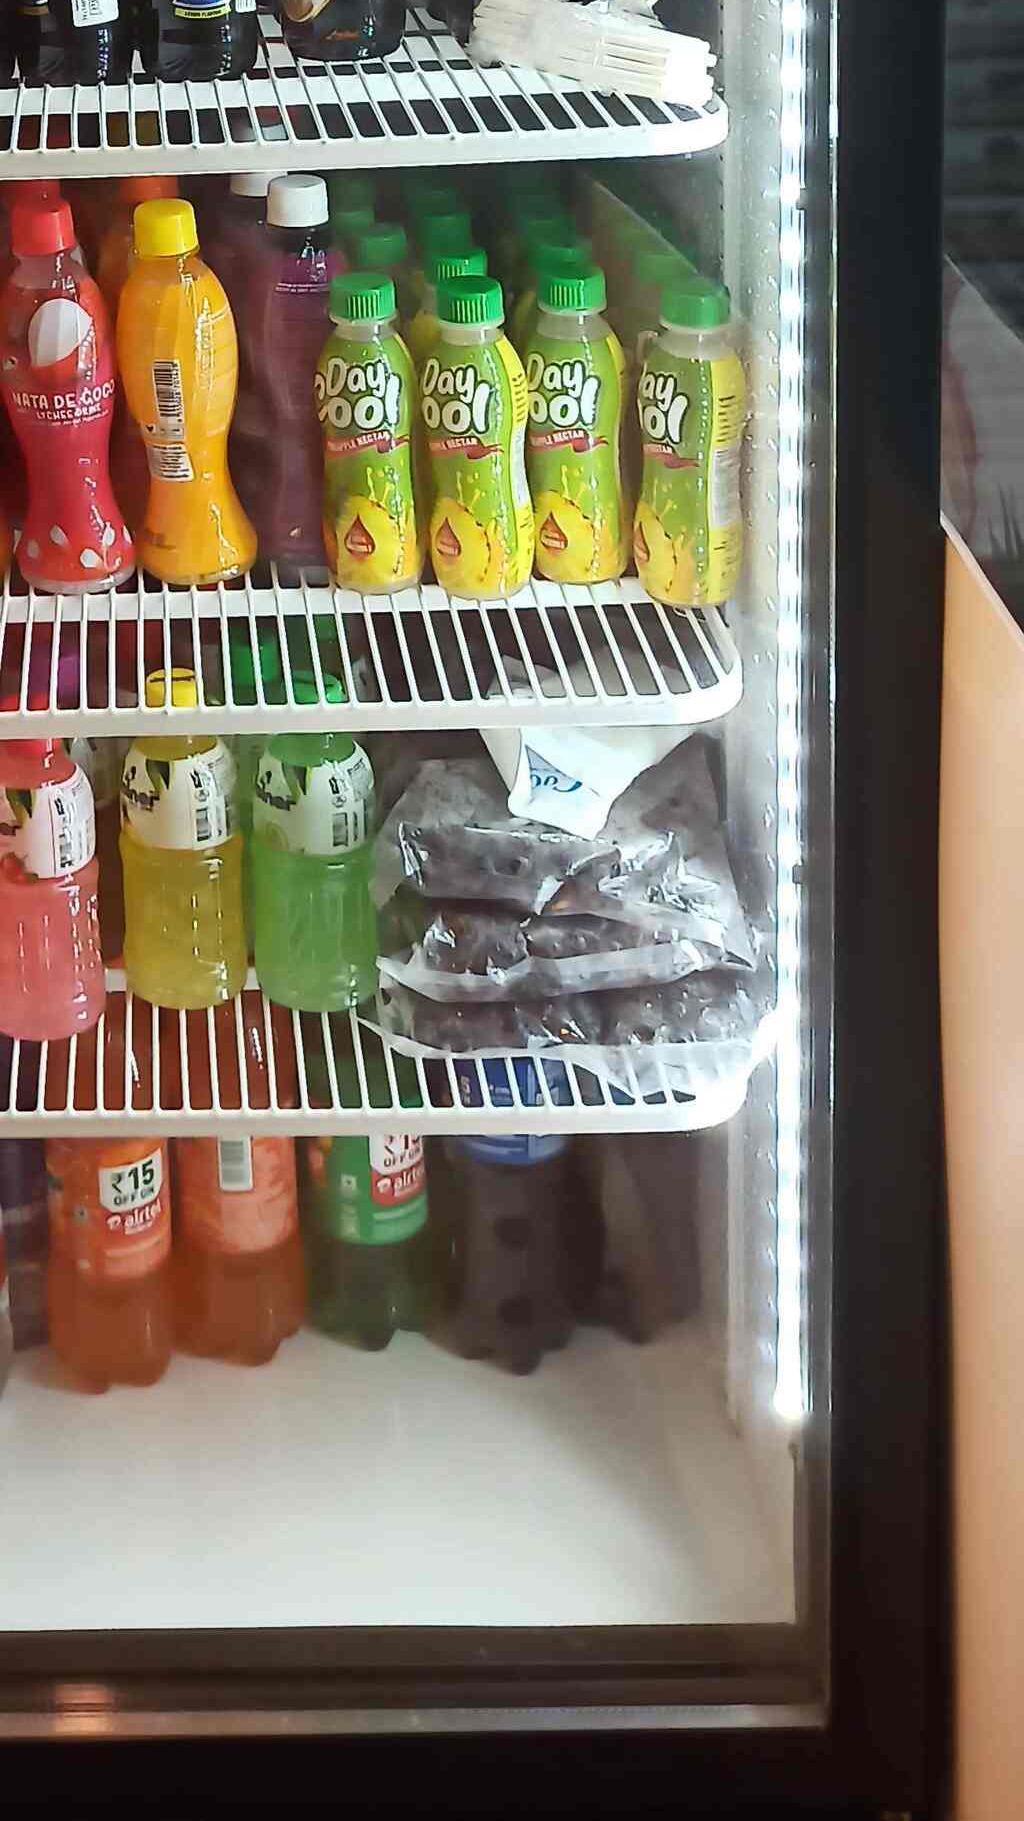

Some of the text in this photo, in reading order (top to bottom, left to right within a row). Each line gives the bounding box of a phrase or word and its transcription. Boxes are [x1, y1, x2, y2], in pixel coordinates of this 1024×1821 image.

[326, 356, 387, 398] Day
[422, 357, 475, 404] Day
[526, 352, 584, 397] Day
[12, 391, 49, 410] NATA
[54, 393, 76, 410] DE
